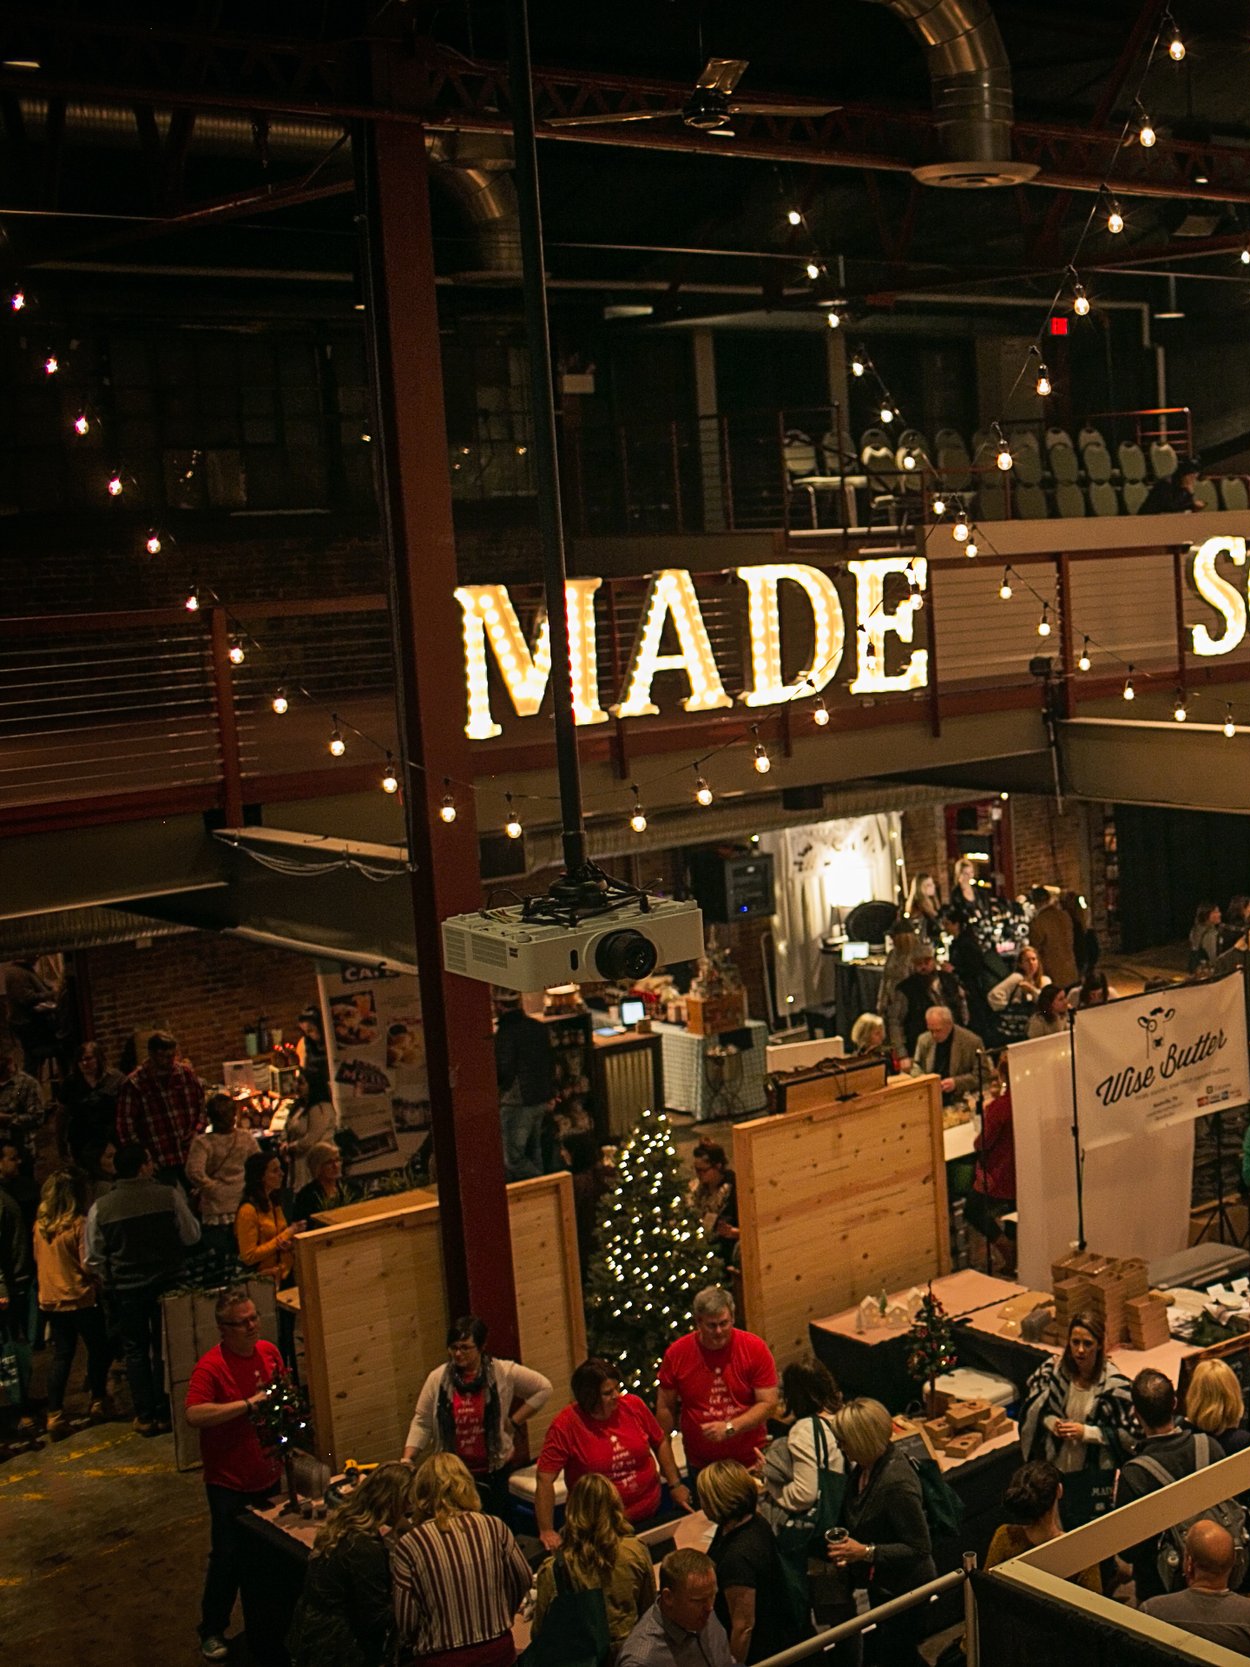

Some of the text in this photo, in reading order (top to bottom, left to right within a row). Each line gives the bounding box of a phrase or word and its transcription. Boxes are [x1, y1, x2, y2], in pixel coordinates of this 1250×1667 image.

[454, 556, 928, 740] MADE
[1096, 1066, 1155, 1106] Wise
[1160, 1028, 1228, 1079] Butter
